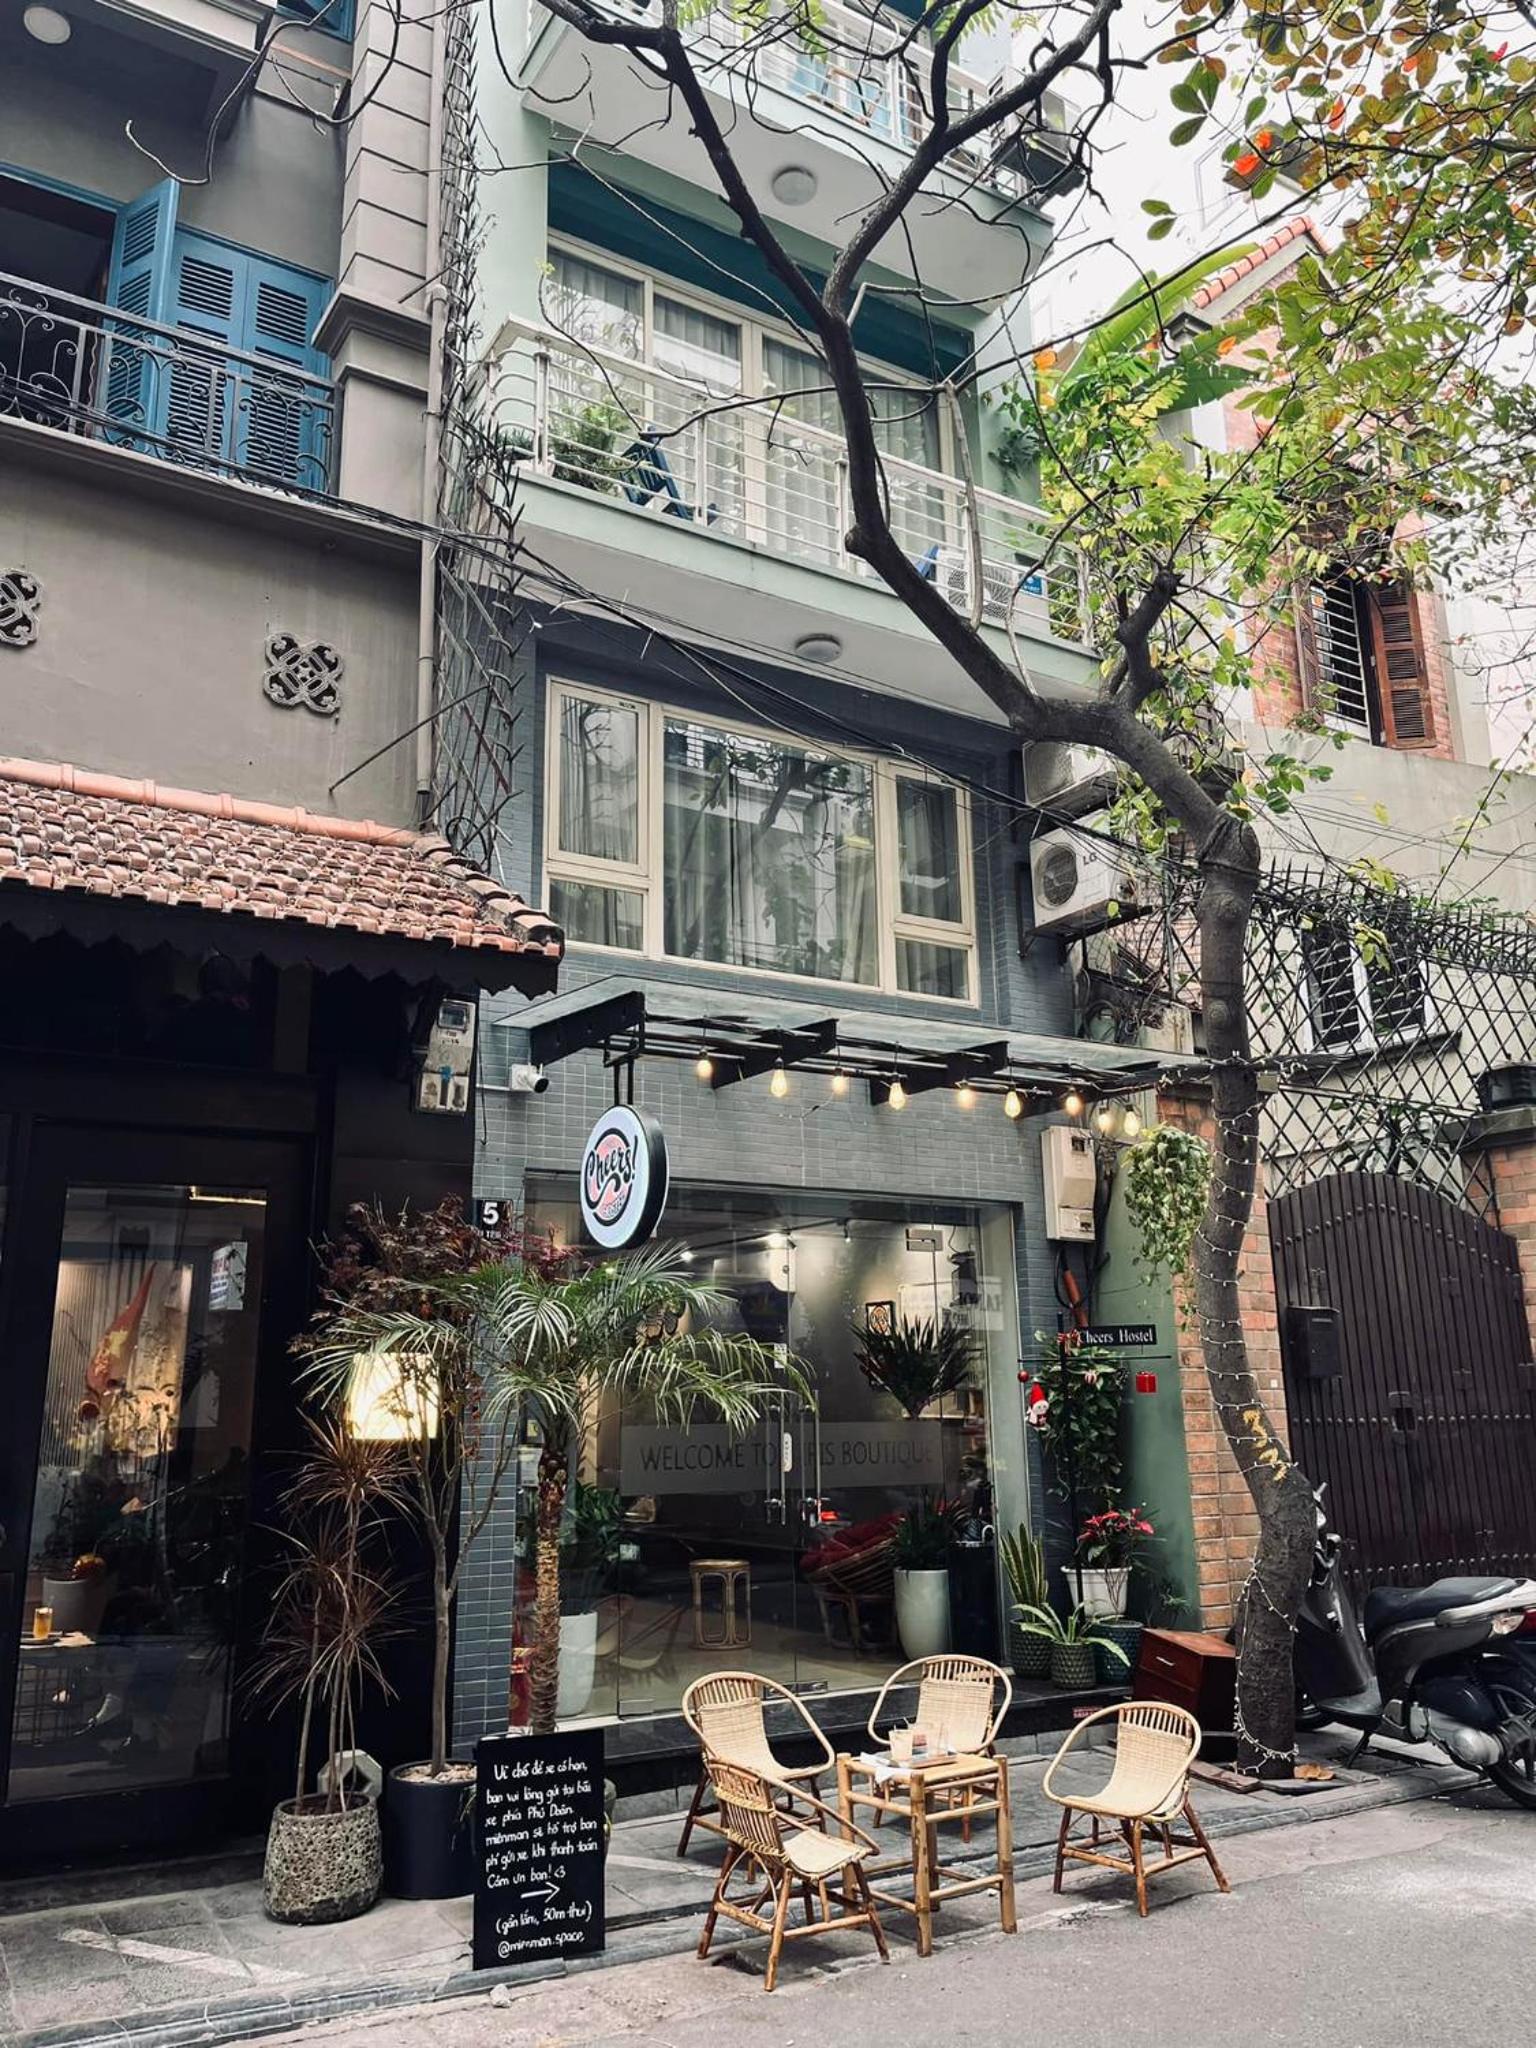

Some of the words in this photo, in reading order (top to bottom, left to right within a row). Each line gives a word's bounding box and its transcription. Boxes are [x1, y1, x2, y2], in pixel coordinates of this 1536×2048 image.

[1083, 852, 1097, 866] LG
[482, 1201, 500, 1226] 5
[1082, 1329, 1114, 1344] heers
[1118, 1328, 1153, 1343] Hostel
[640, 1441, 745, 1472] WELCOME
[751, 1441, 777, 1468] TO
